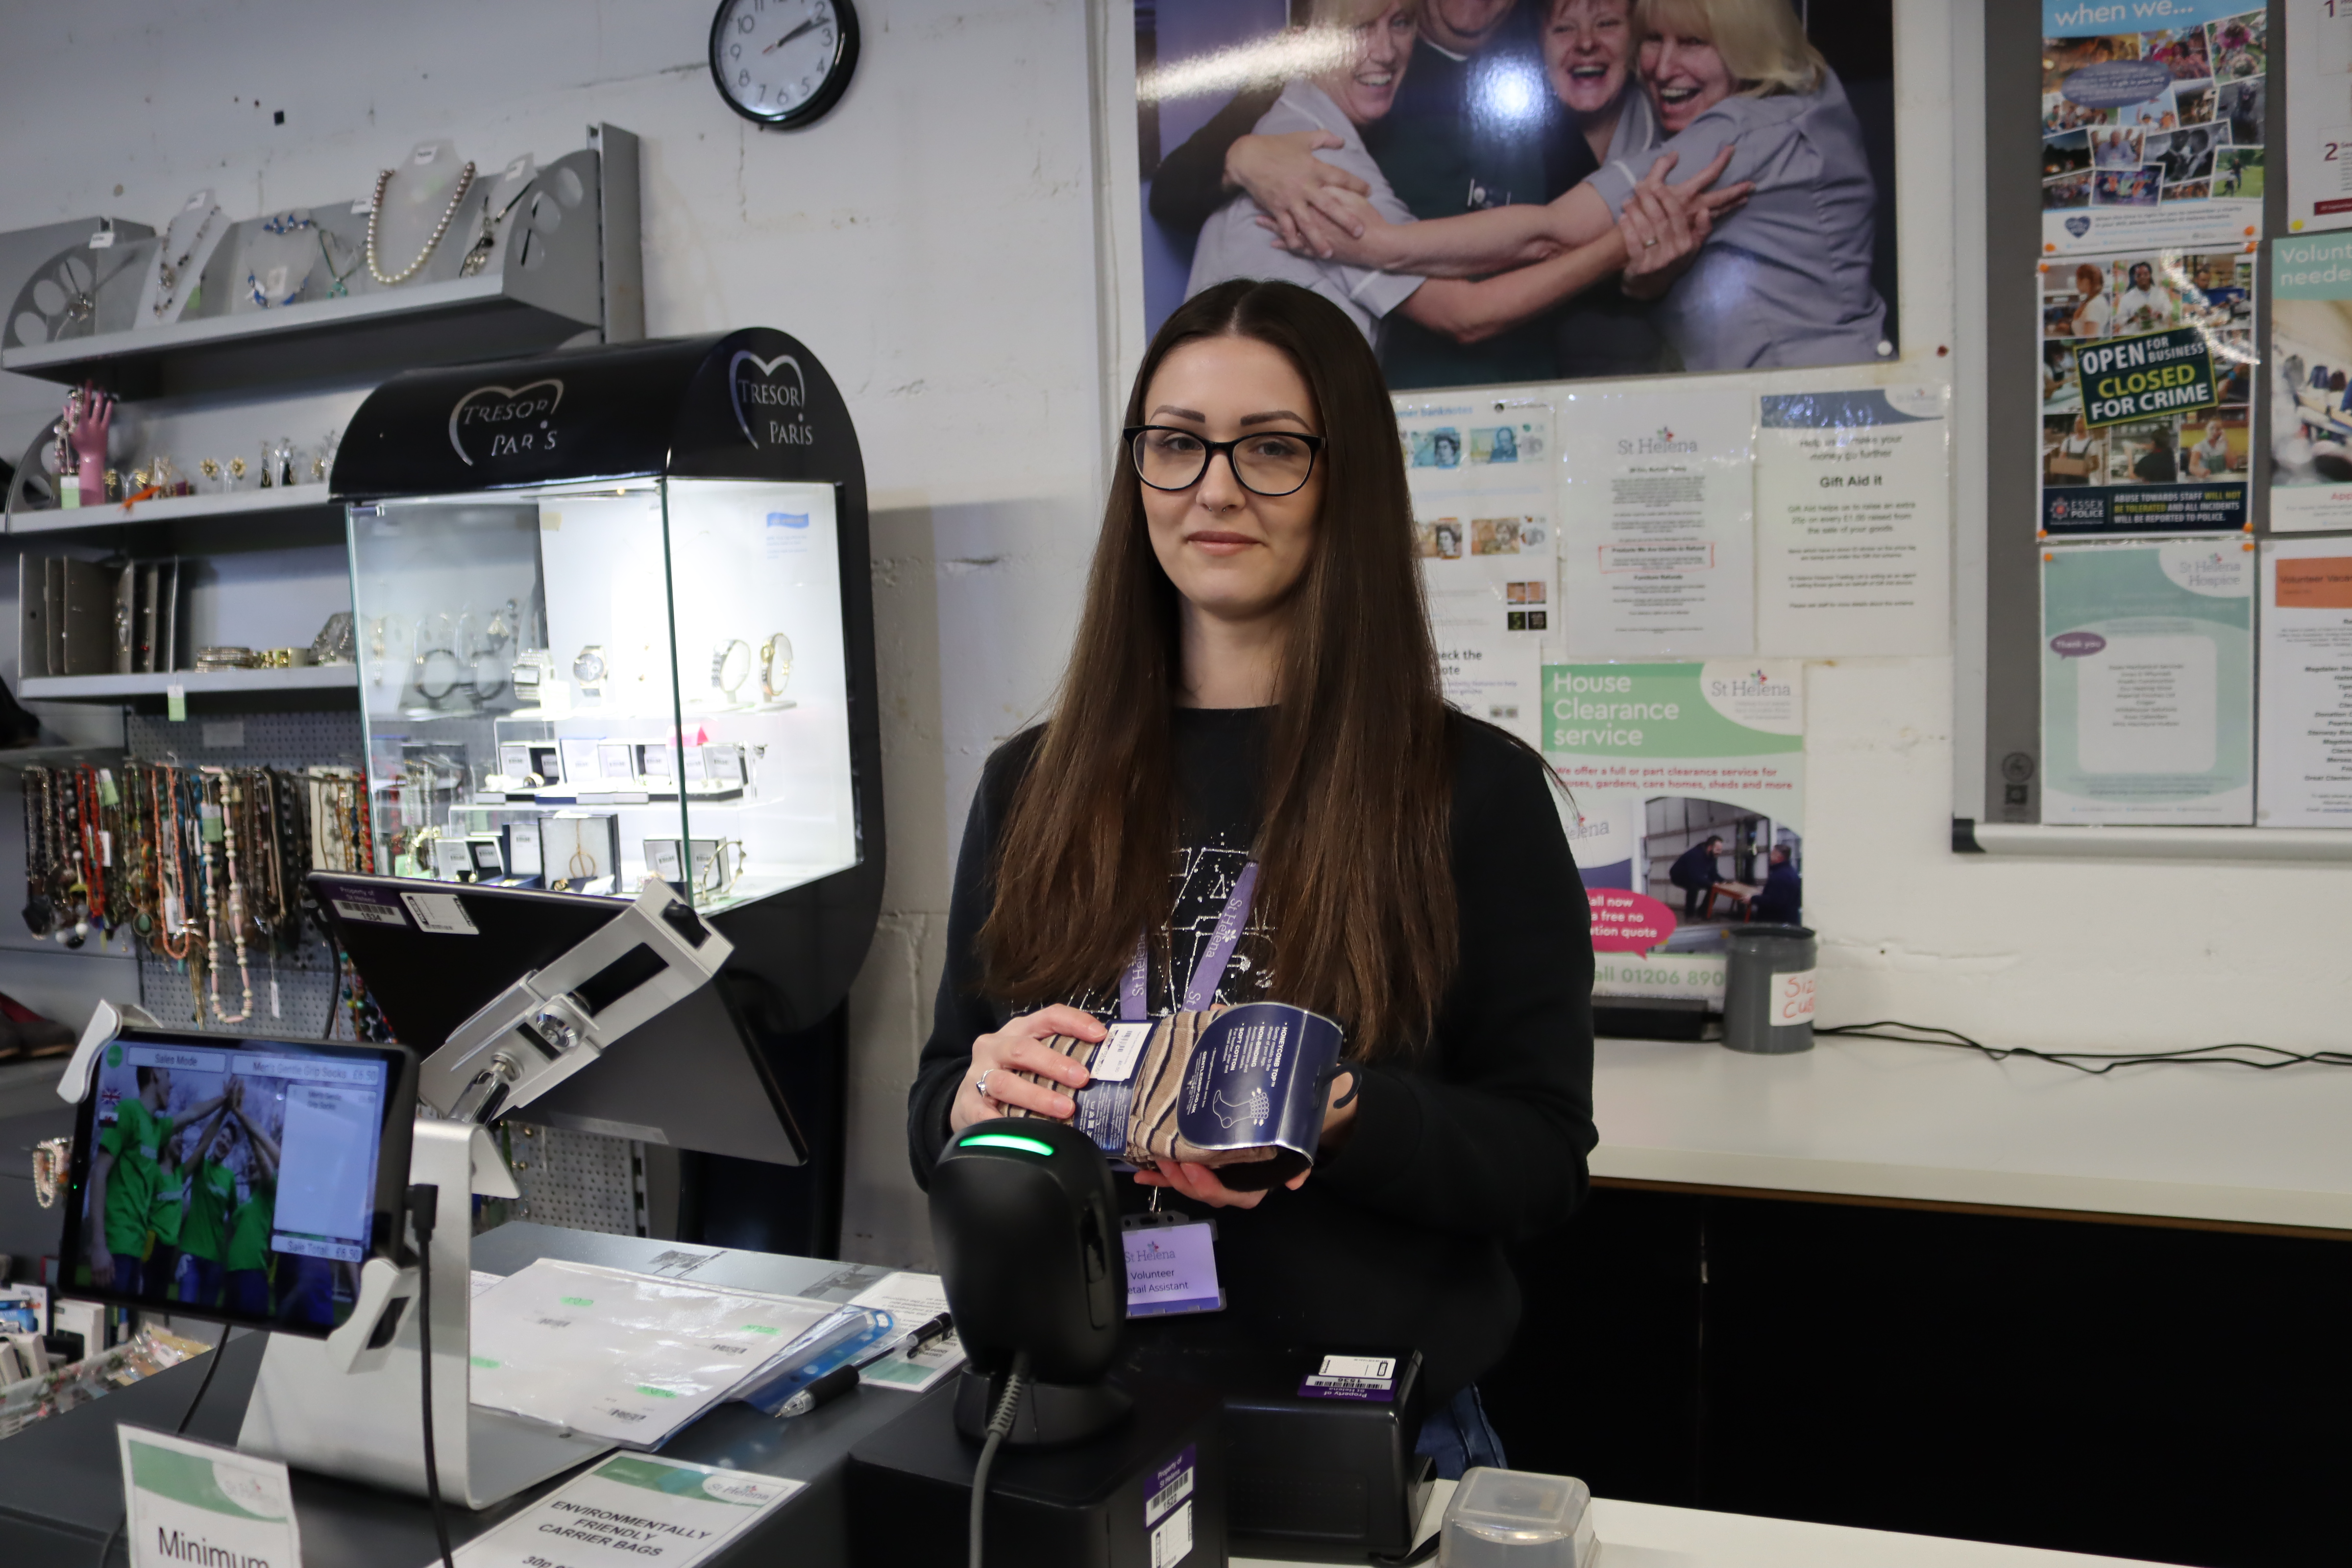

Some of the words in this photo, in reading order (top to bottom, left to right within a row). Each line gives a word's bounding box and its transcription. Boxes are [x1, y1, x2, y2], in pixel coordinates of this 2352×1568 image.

[2055, 2, 2126, 27] when
[2324, 0, 2334, 18] 1
[737, 15, 754, 34] 10
[821, 27, 833, 47] 3
[730, 44, 741, 61] 9
[816, 57, 825, 74] 4
[738, 69, 750, 87] 8
[801, 77, 809, 97] 5
[759, 84, 766, 102] 7
[777, 89, 788, 106] 6
[2325, 142, 2338, 161] 2
[2082, 342, 2146, 375] OPEN
[2146, 336, 2169, 351] FOR
[2147, 343, 2205, 364] BUSINESS
[2098, 364, 2196, 398] CLOSED
[2091, 396, 2135, 420] FOR
[2138, 383, 2210, 411] CRIME
[1618, 440, 1634, 455] St
[1639, 438, 1698, 455] Helena
[1820, 476, 1843, 488] Gift
[1848, 475, 1870, 487] Aid
[1874, 475, 1882, 486] it
[2071, 499, 2104, 510] ESSEX
[2114, 493, 2139, 503] ABUSE
[2141, 492, 2179, 502] TOWARDS
[2180, 492, 2203, 501] STAFF
[2071, 510, 2104, 518] POLICE
[2180, 562, 2192, 574] St
[2195, 561, 2241, 572] Helena
[2189, 575, 2241, 588] Hospice
[1463, 649, 1483, 661] the
[1552, 672, 1632, 694] House
[1712, 680, 1728, 697] St
[1732, 680, 1791, 697] Helena
[1553, 699, 1680, 721] Clearance
[1553, 723, 1643, 747] service
[1555, 767, 1571, 775] We
[1574, 766, 1598, 776] offer
[1610, 766, 1626, 776] full
[1643, 768, 1665, 778] part
[1667, 767, 1718, 777] clearance
[1721, 768, 1759, 777] service
[1763, 768, 1777, 777] for
[1596, 781, 1640, 791] gardens,
[1668, 780, 1706, 790] homes,
[1709, 780, 1739, 789] sheds
[1742, 781, 1762, 789] and
[1227, 897, 1243, 912] St
[1606, 897, 1634, 907] now
[1601, 909, 1625, 922] free
[1628, 913, 1645, 923] no
[1205, 912, 1237, 959] Helena
[1620, 928, 1658, 940] quote
[1132, 933, 1145, 981] Helena
[1621, 969, 1681, 985] 01206
[1132, 982, 1145, 997] St
[1186, 990, 1201, 1006] St
[1243, 1027, 1251, 1054] compression
[1251, 1026, 1265, 1067] NON-BINDING
[1274, 1027, 1288, 1067] HONEYCOMB
[155, 1054, 174, 1064] Sales
[176, 1055, 197, 1066] Mode
[1230, 1045, 1240, 1071] COTTON
[1246, 1042, 1254, 1063] restriction
[1191, 1051, 1207, 1114] GENTLEGRIP.CO.UK
[1125, 1250, 1135, 1263] St
[1137, 1249, 1176, 1263] Helena
[1130, 1269, 1175, 1280] Volunteer
[1149, 1281, 1189, 1293] Assistant
[1157, 1460, 1177, 1480] Property
[1177, 1455, 1182, 1465] of
[1159, 1480, 1165, 1489] St
[1165, 1469, 1180, 1485] Helena
[1163, 1493, 1177, 1512] 1522
[550, 1500, 712, 1540] ENVIRONMENTALLY
[573, 1518, 659, 1542] FRIENDLY
[538, 1523, 612, 1546] CARRIER
[612, 1540, 663, 1557] BAGS
